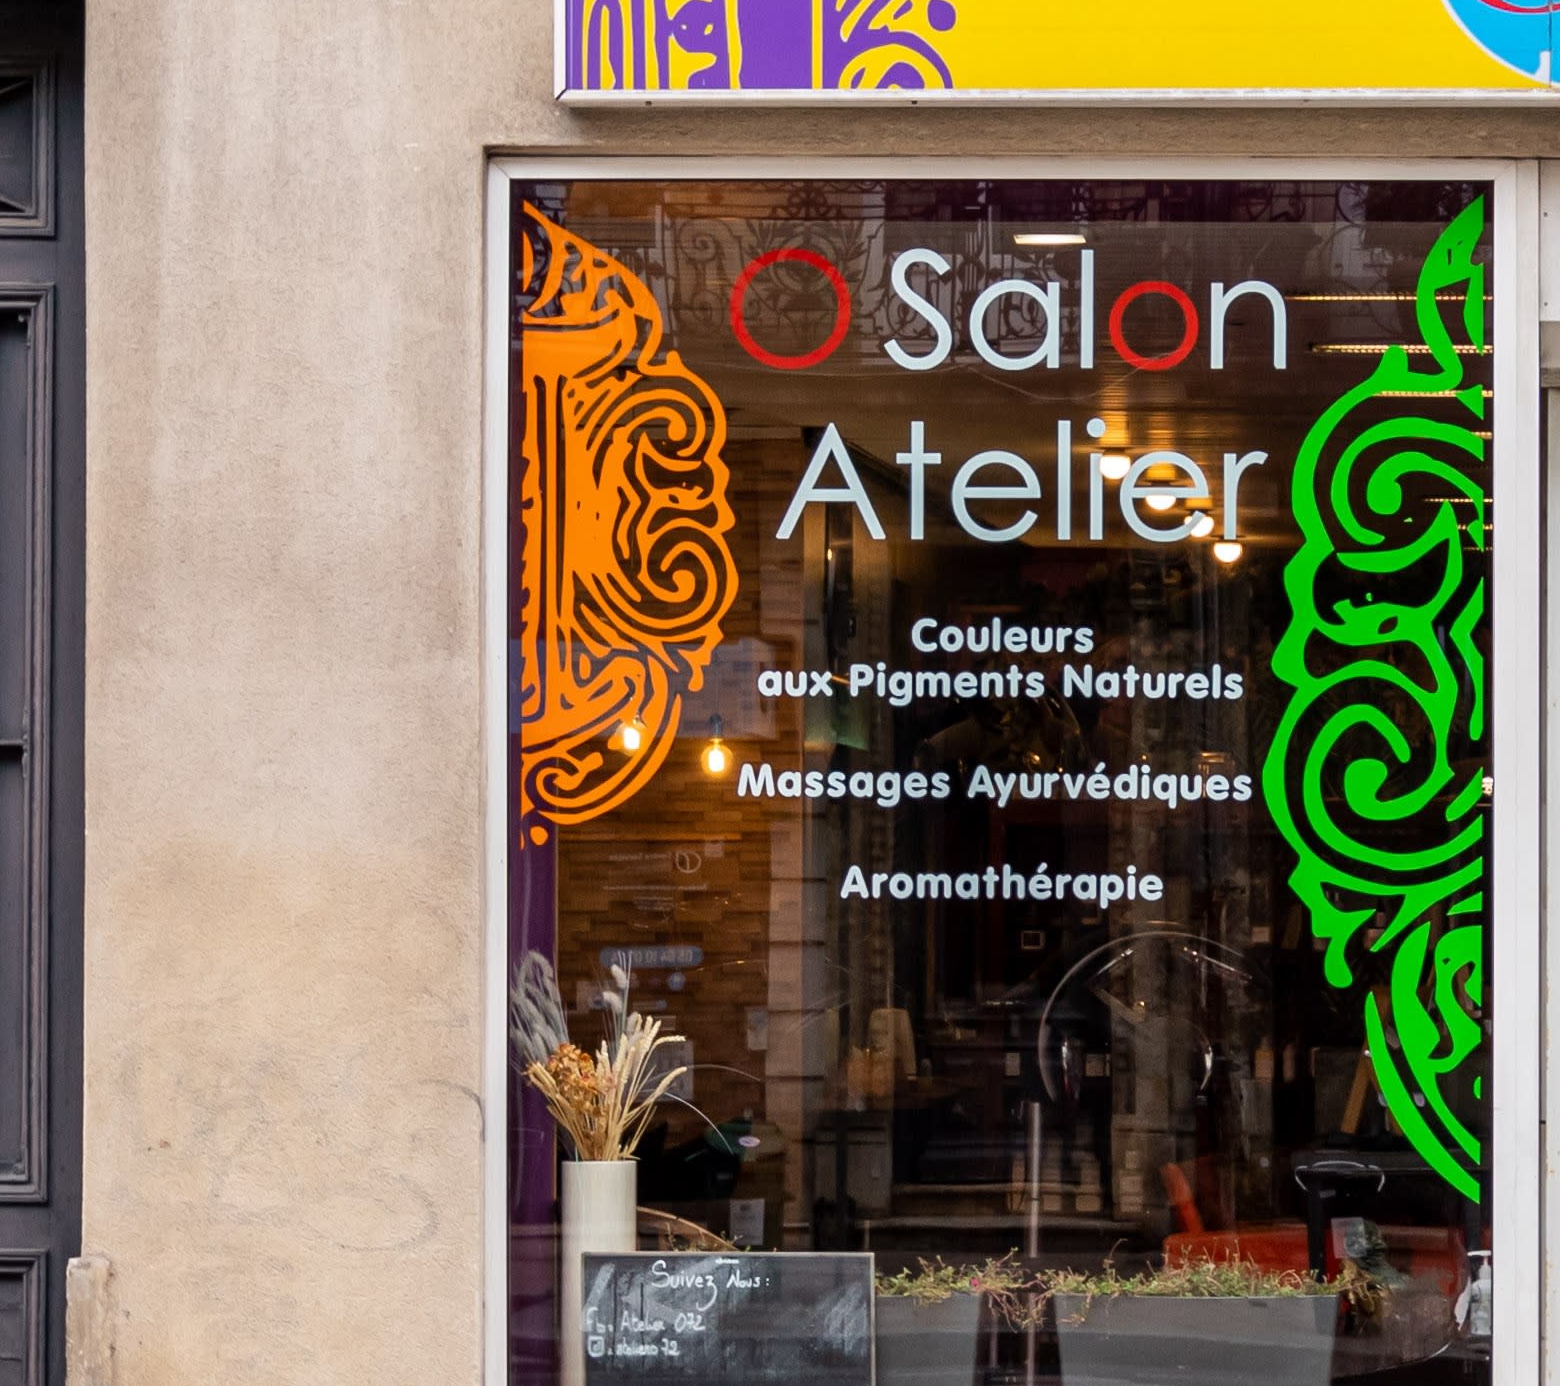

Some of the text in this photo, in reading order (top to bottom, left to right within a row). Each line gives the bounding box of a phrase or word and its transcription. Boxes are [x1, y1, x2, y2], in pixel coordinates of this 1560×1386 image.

[730, 248, 1288, 371] O Salon
[775, 417, 1268, 542] Atelier
[911, 617, 1094, 654] Couleurs
[757, 663, 1244, 706] aux Pigments Naturels
[737, 763, 1253, 808] Massages Ayurvédiques
[840, 862, 1164, 909] Aromathérapie
[651, 1259, 718, 1311] Suivez
